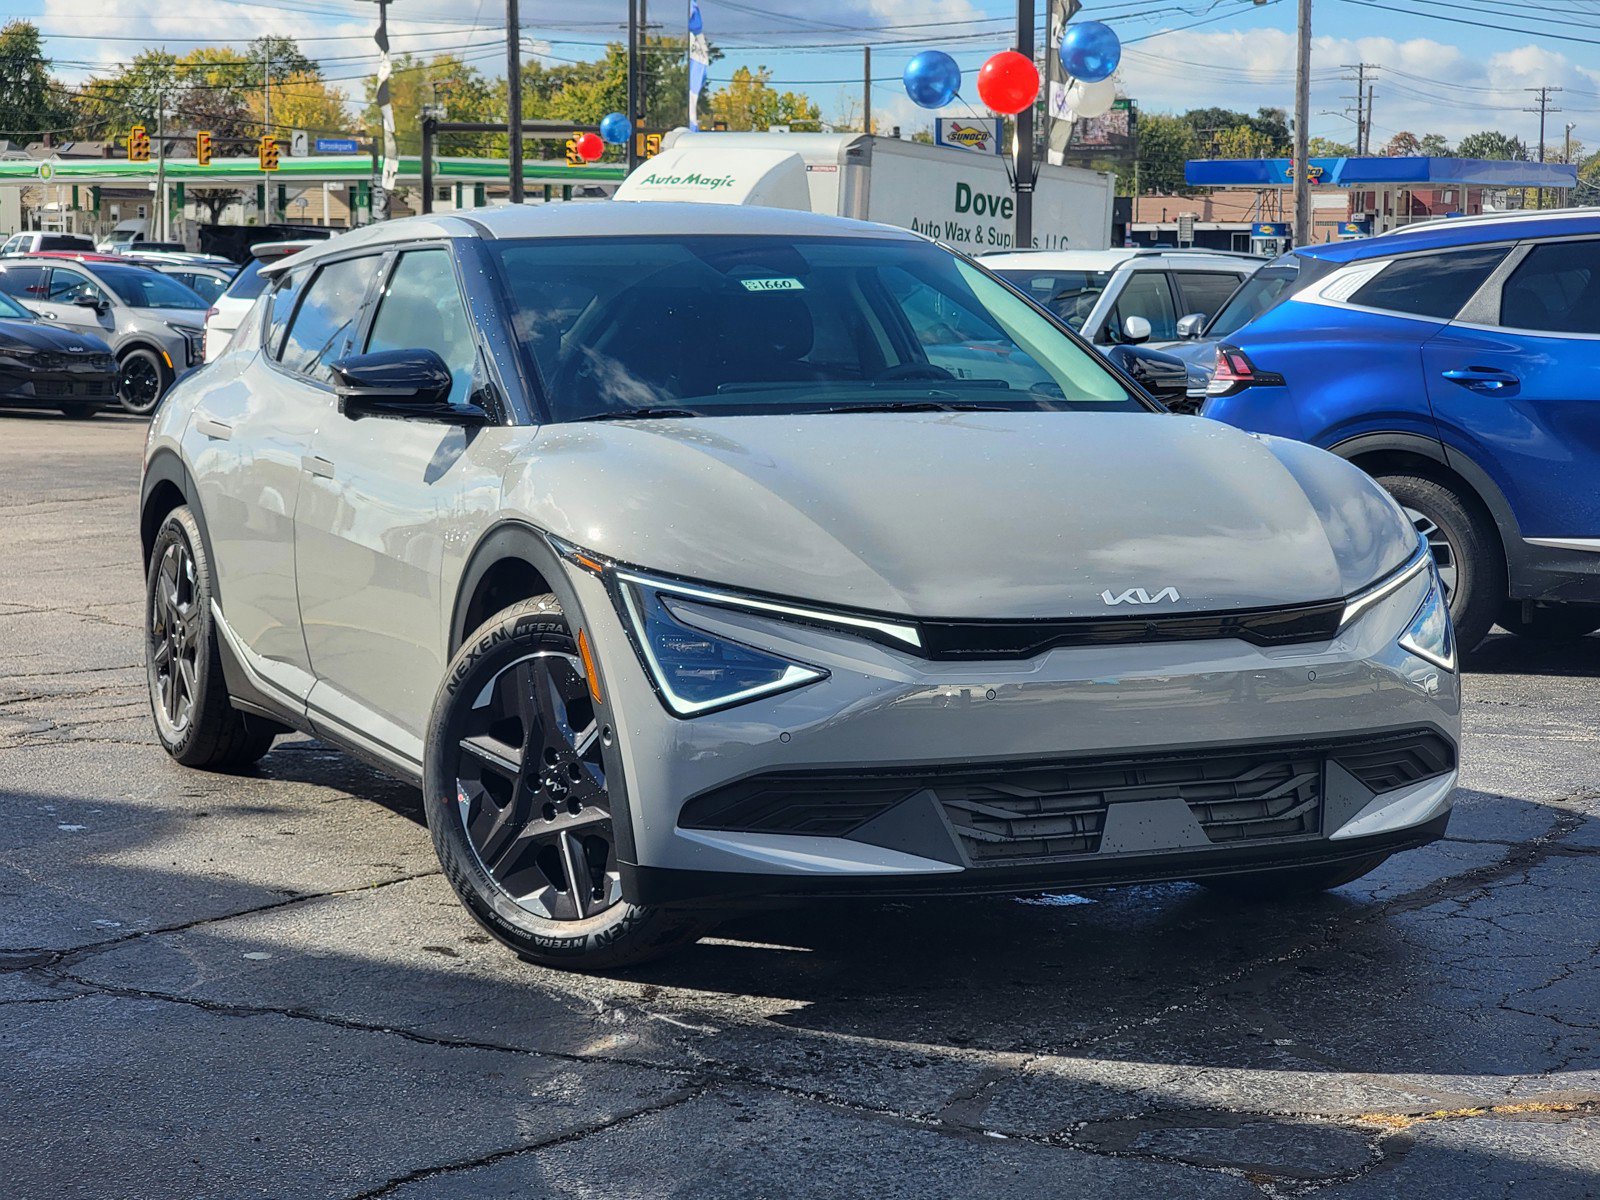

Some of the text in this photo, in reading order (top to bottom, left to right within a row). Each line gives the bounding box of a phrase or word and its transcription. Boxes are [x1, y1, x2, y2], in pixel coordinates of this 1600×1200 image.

[949, 132, 989, 142] SUNOCO
[640, 173, 736, 190] Auto Magic
[911, 217, 941, 240] Auto
[944, 221, 971, 243] Wax
[975, 225, 984, 244] &
[758, 280, 792, 289] 1660
[1101, 587, 1180, 606] KIA
[446, 623, 509, 696] NEXEN
